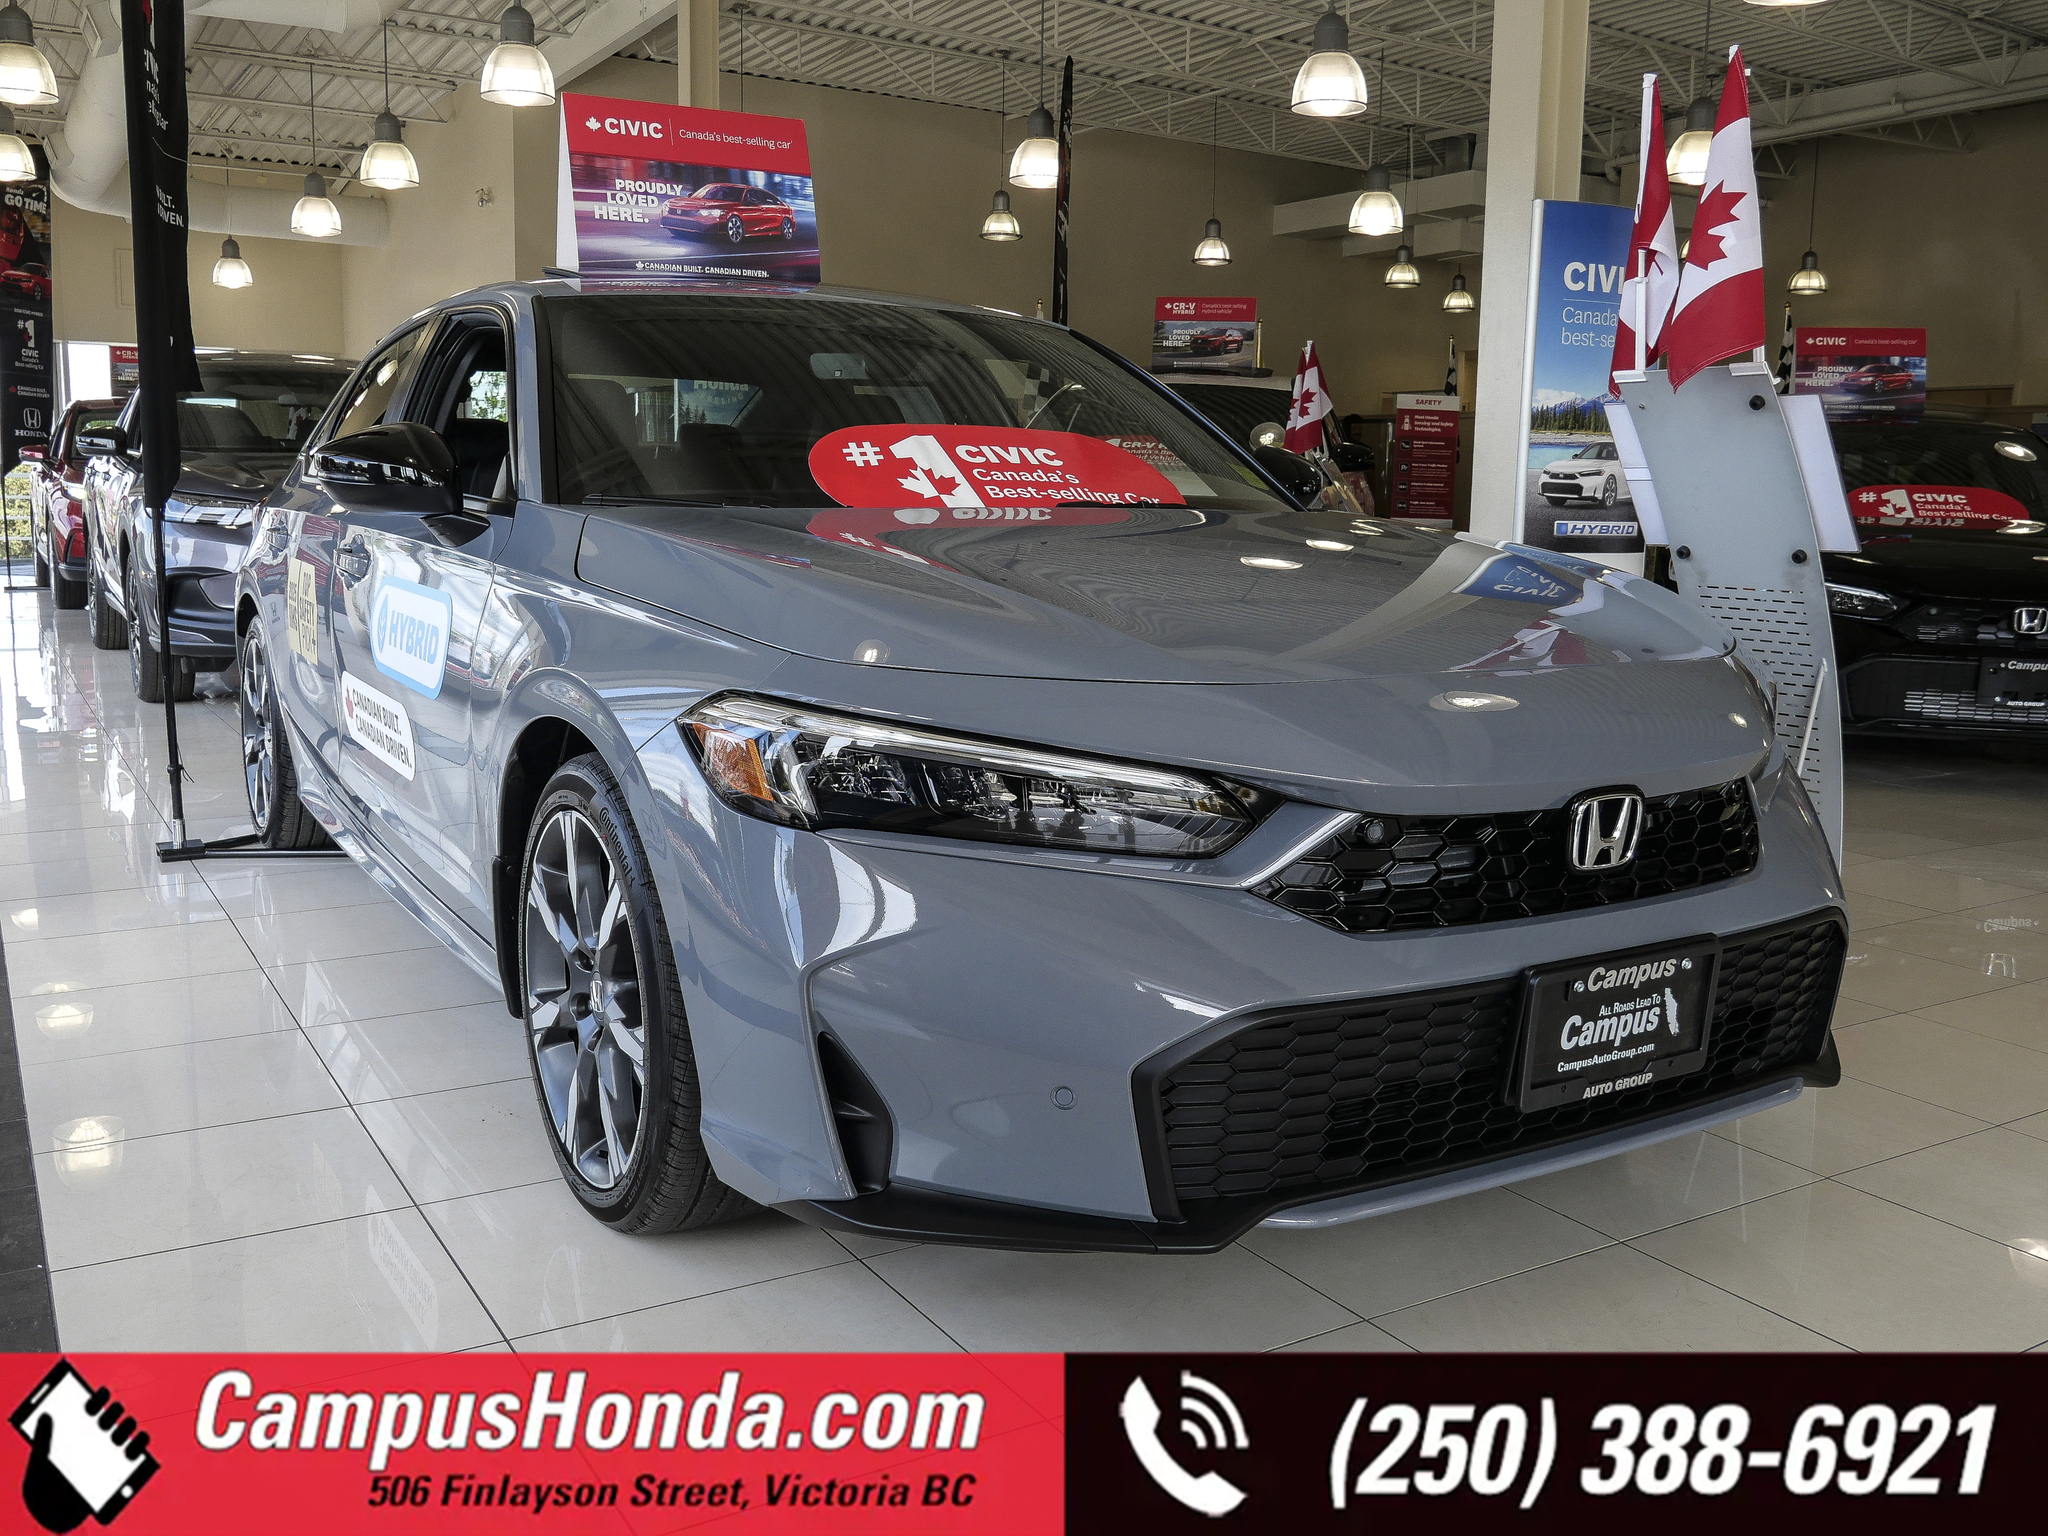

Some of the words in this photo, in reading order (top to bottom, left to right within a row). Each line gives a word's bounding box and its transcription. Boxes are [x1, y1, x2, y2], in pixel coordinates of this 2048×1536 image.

[604, 118, 664, 139] CIVIC
[679, 129, 722, 142] Canada's
[723, 133, 775, 150] best-selling
[615, 179, 683, 196] PROUDLY
[4, 194, 23, 208] GO
[24, 198, 47, 214] TIME
[606, 192, 659, 207] LOVED
[594, 205, 650, 223] HERE.
[645, 262, 682, 272] CANADIAN
[684, 265, 704, 273] BUILT.
[705, 266, 741, 276] CANADIAN
[742, 269, 770, 278] DRIVEN.
[1563, 261, 1626, 295] CIVI
[1173, 302, 1196, 310] CR-V
[1816, 337, 1847, 346] CIVIC
[22, 348, 38, 358] CIVIC
[14, 430, 48, 438] HONDA
[955, 444, 1064, 467] CIVIC
[972, 468, 1080, 484] Canada's
[984, 485, 1120, 504] Best-selling
[1912, 493, 1968, 503] CIVIC
[1916, 502, 1971, 511] Canada's
[1918, 510, 1990, 520] Best-selling
[1992, 513, 2013, 521] Car
[1570, 524, 1635, 534] HYBRID
[300, 596, 314, 627] SAFETY
[388, 610, 440, 665] HYBRID
[352, 688, 382, 723] CANADIAN
[382, 707, 402, 736] BUILT.
[355, 713, 385, 752] CANADIAN
[384, 734, 412, 768] DRIVEN.
[600, 807, 632, 878] Continental
[1588, 958, 1677, 992] Campus
[1613, 1002, 1634, 1013] ROADS
[1636, 998, 1651, 1009] LEAD
[1560, 1006, 1660, 1050] Campus
[1558, 1043, 1654, 1072] CampusAutoGroup.com
[1583, 1081, 1612, 1100] AUTO
[1615, 1072, 1652, 1094] GROUP
